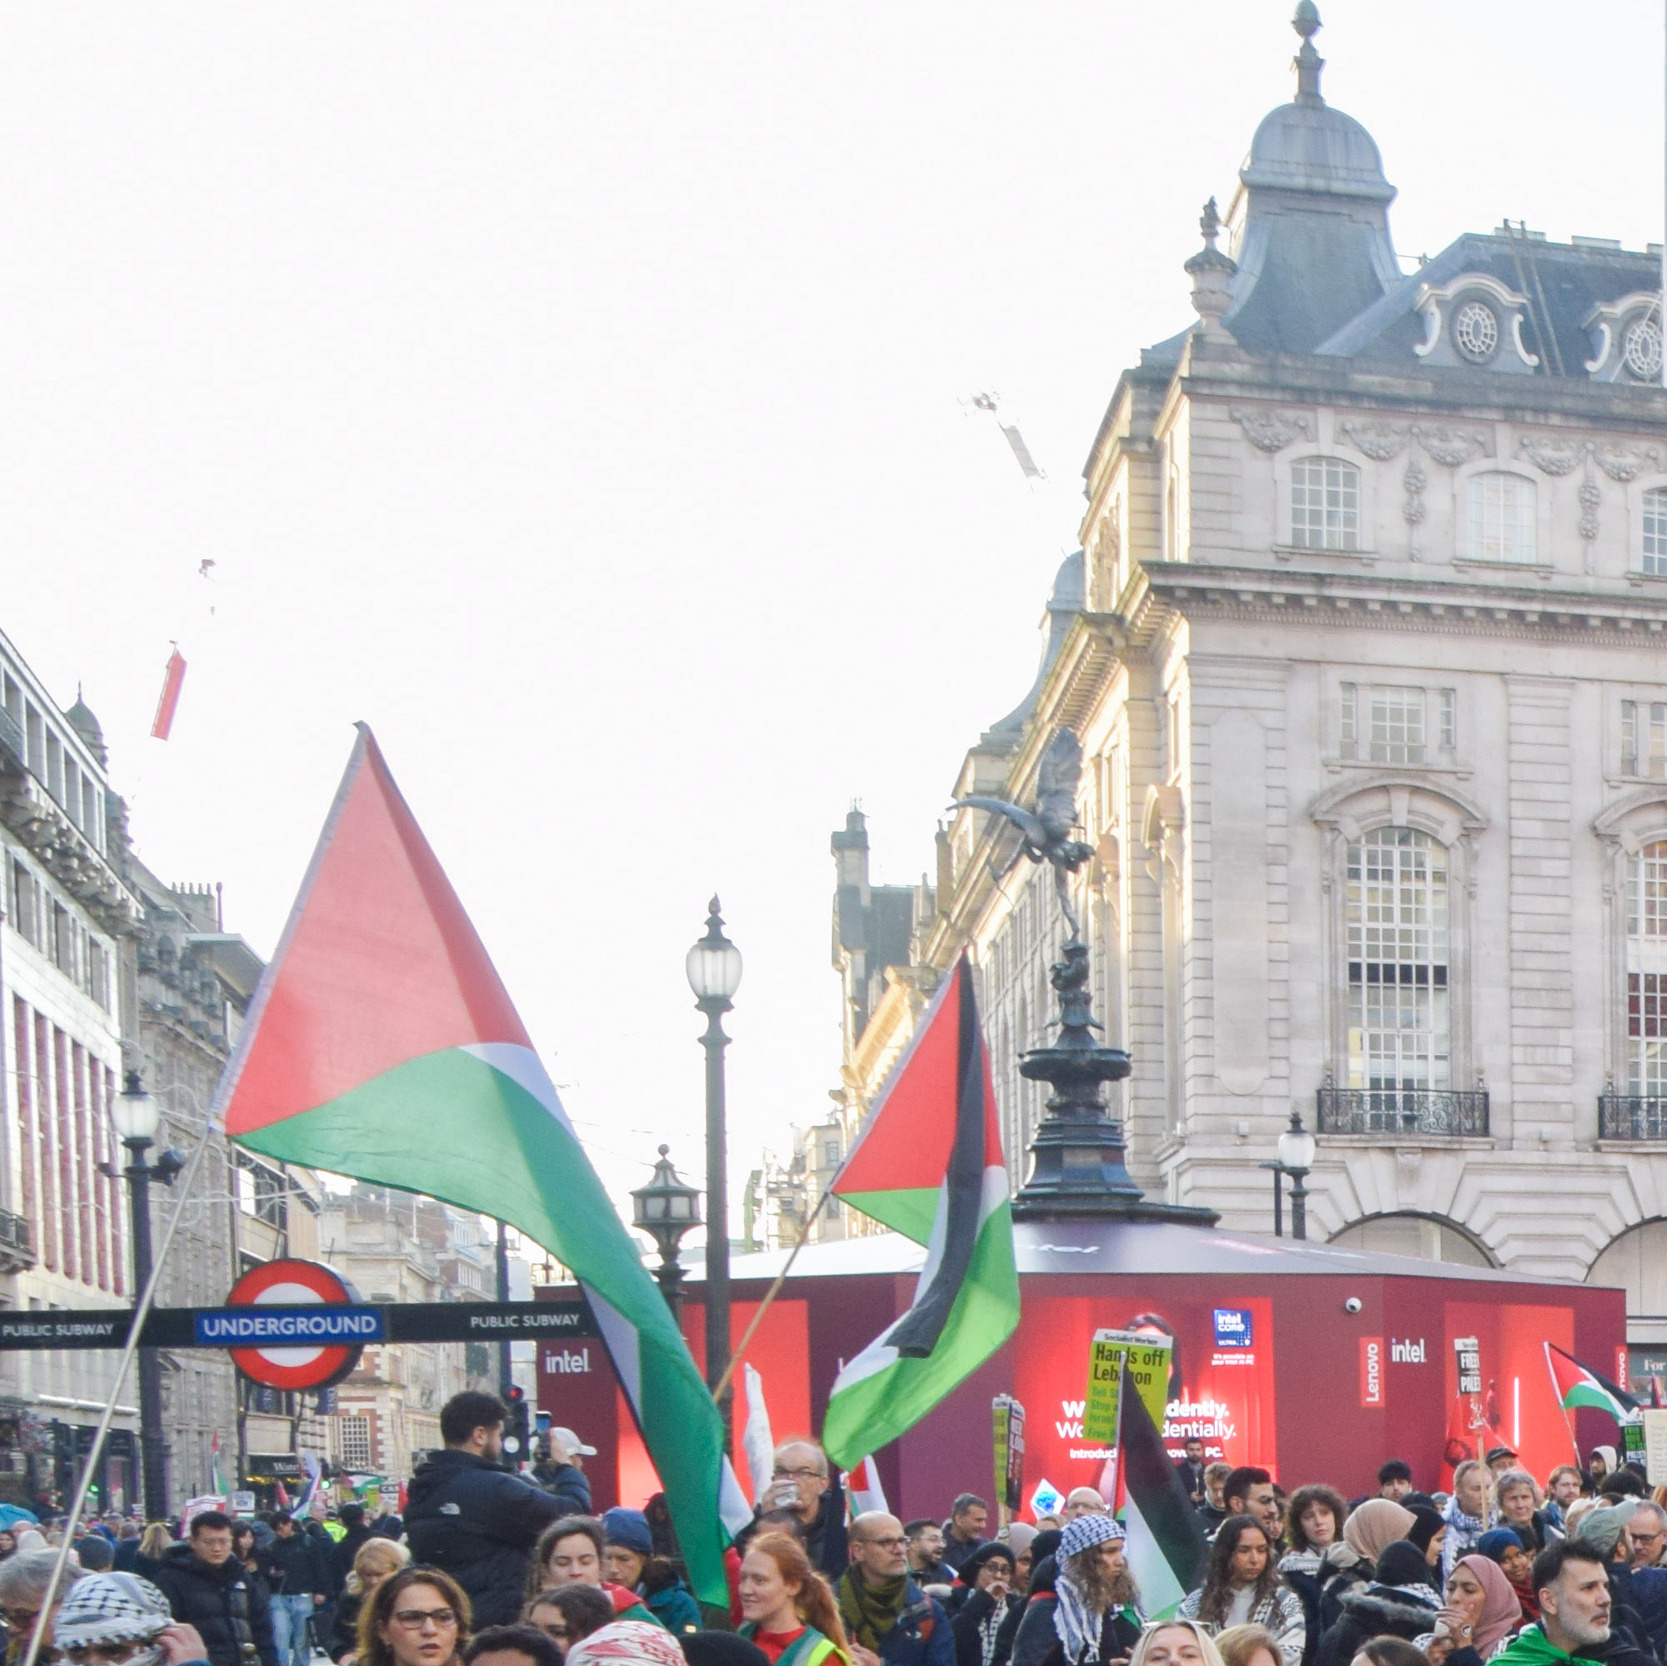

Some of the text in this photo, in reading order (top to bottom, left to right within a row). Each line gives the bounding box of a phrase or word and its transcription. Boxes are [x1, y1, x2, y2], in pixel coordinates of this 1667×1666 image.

[2, 1321, 114, 1338] PUBLIC SUBWAY
[202, 1315, 378, 1339] UNDERGROUND
[470, 1313, 581, 1329] PUBLIC SUBWAY
[1143, 1348, 1165, 1367] off
[1643, 1358, 1667, 1371] For
[1366, 1343, 1380, 1403] Lenovo
[1069, 1448, 1117, 1460] Introduci
